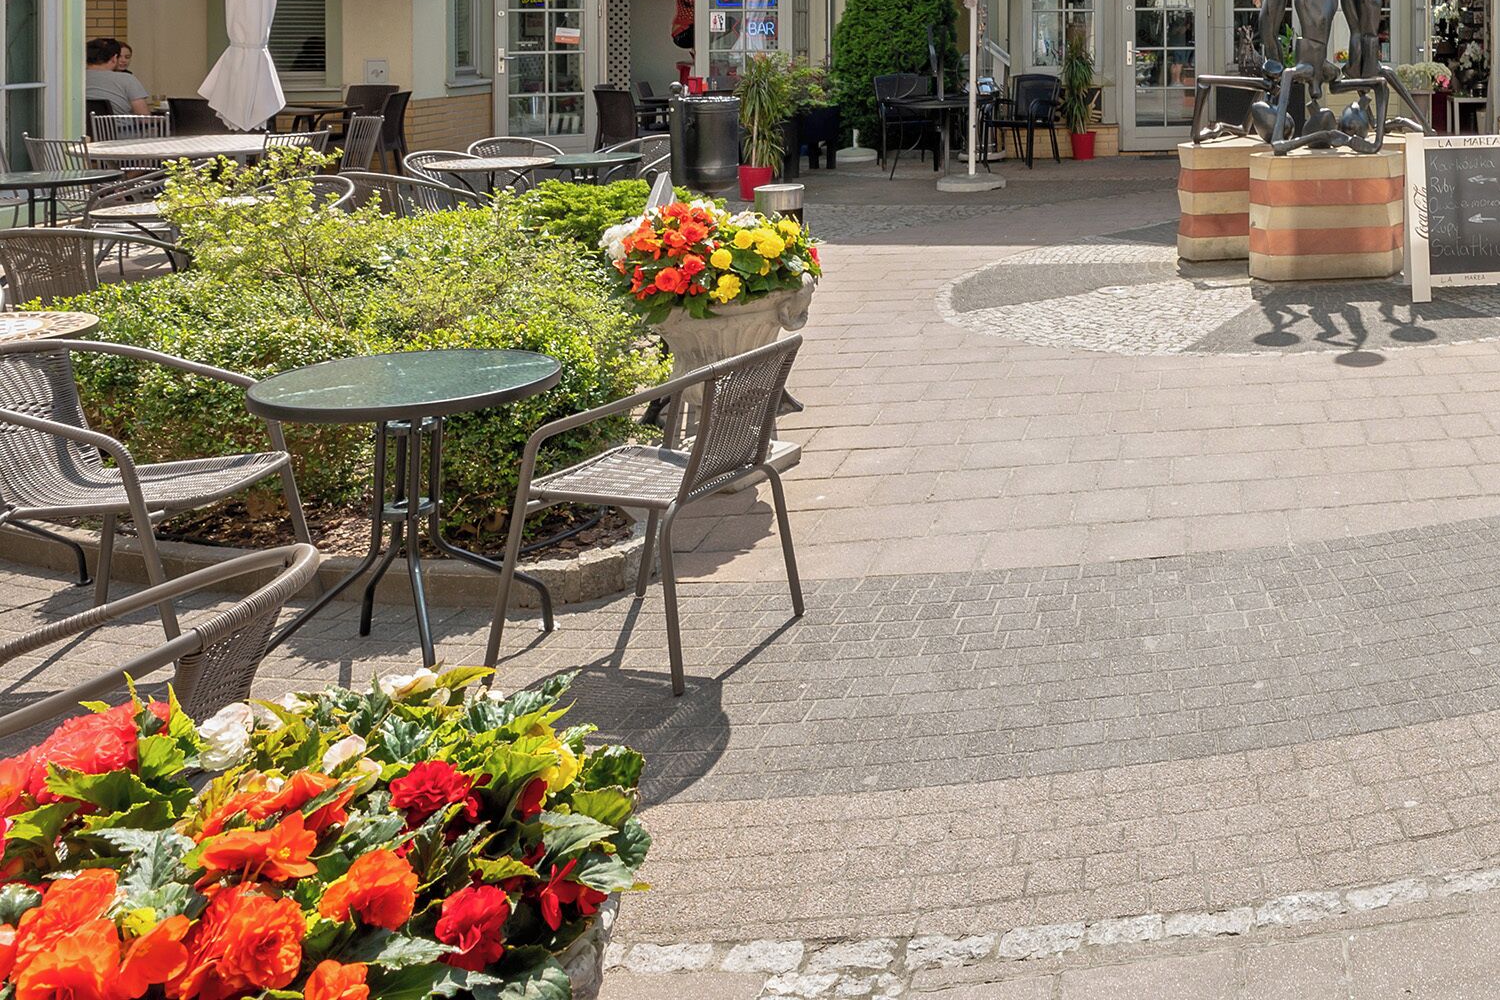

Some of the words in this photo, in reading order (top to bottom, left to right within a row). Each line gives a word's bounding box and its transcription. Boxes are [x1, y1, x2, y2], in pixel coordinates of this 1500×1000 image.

[748, 22, 775, 36] BAR
[1438, 140, 1453, 148] LA
[1463, 138, 1500, 147] MAREA
